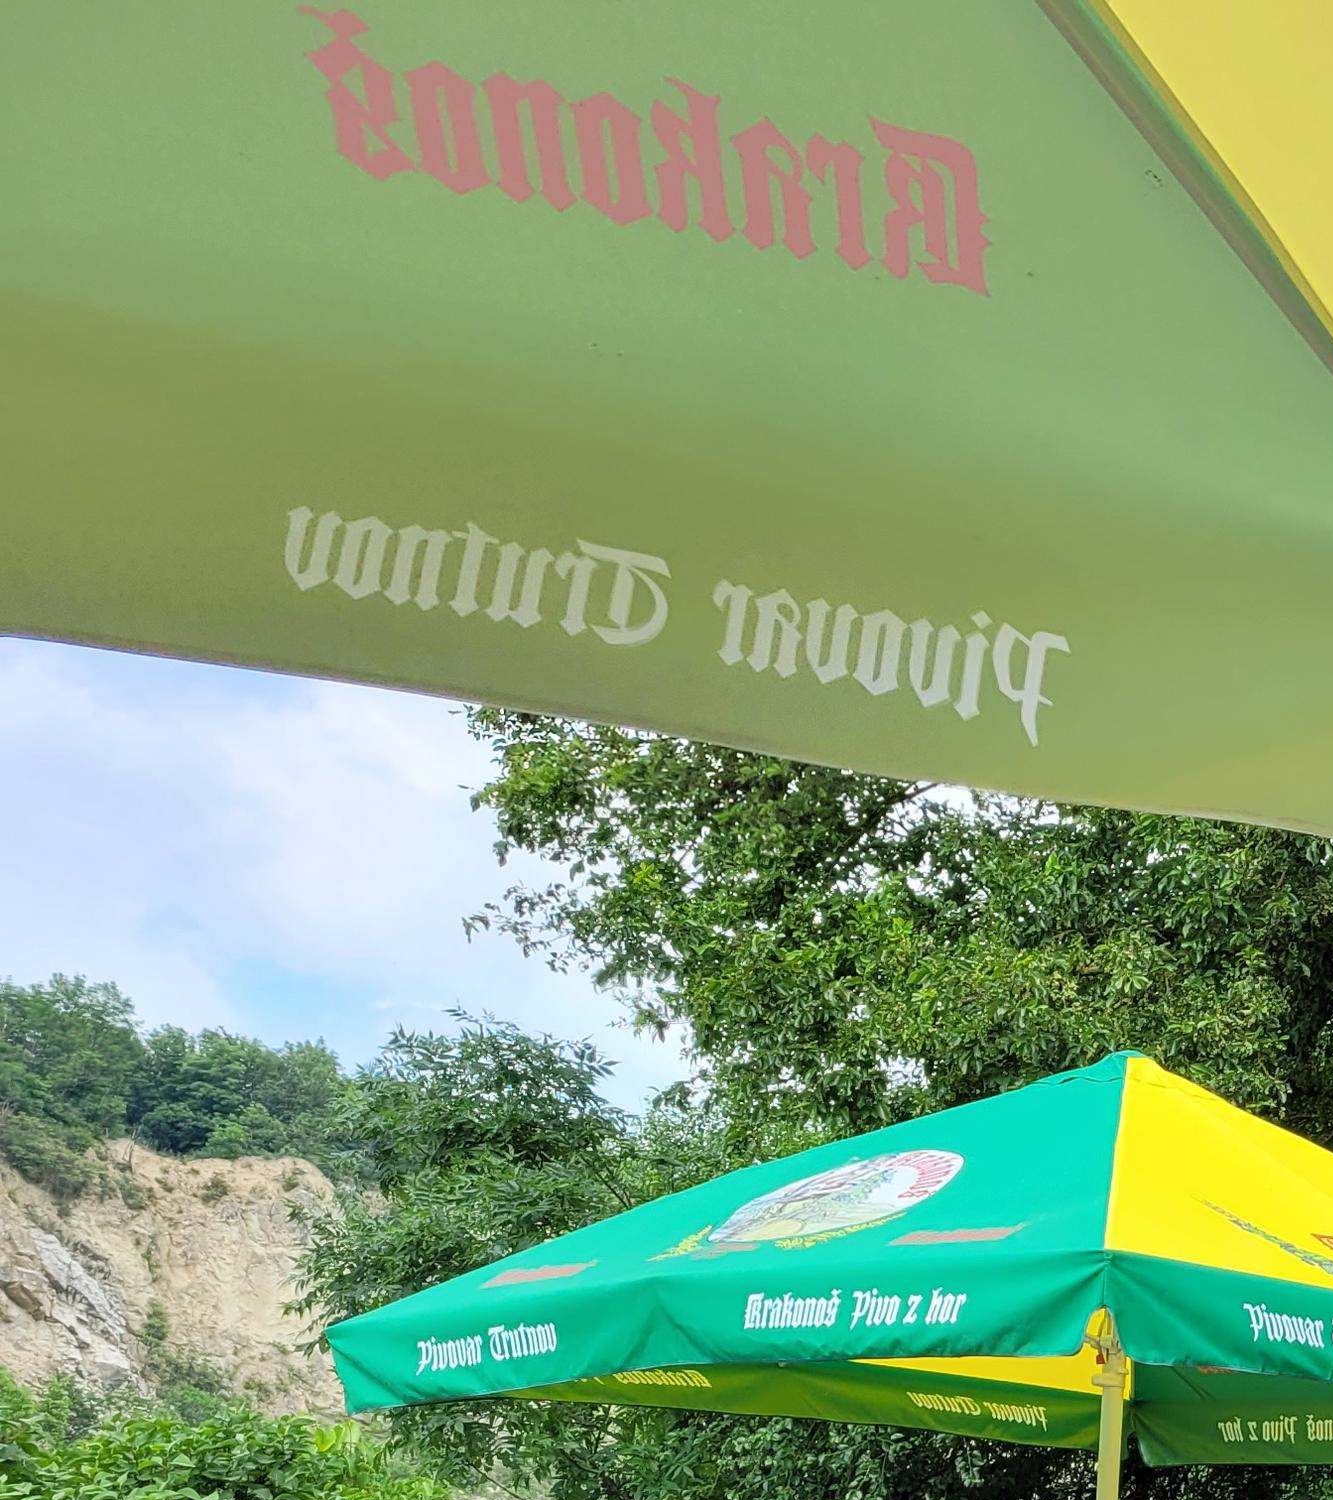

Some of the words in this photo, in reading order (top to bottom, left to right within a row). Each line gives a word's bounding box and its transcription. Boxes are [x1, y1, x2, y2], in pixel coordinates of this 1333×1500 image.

[743, 1288, 842, 1330] Krakonoš
[850, 1287, 902, 1330] Pivo
[903, 1294, 923, 1325] z
[925, 1286, 968, 1325] hor
[1243, 1303, 1325, 1349] Pivovar
[416, 1335, 483, 1376] Pivovar
[488, 1322, 557, 1361] Trutnov
